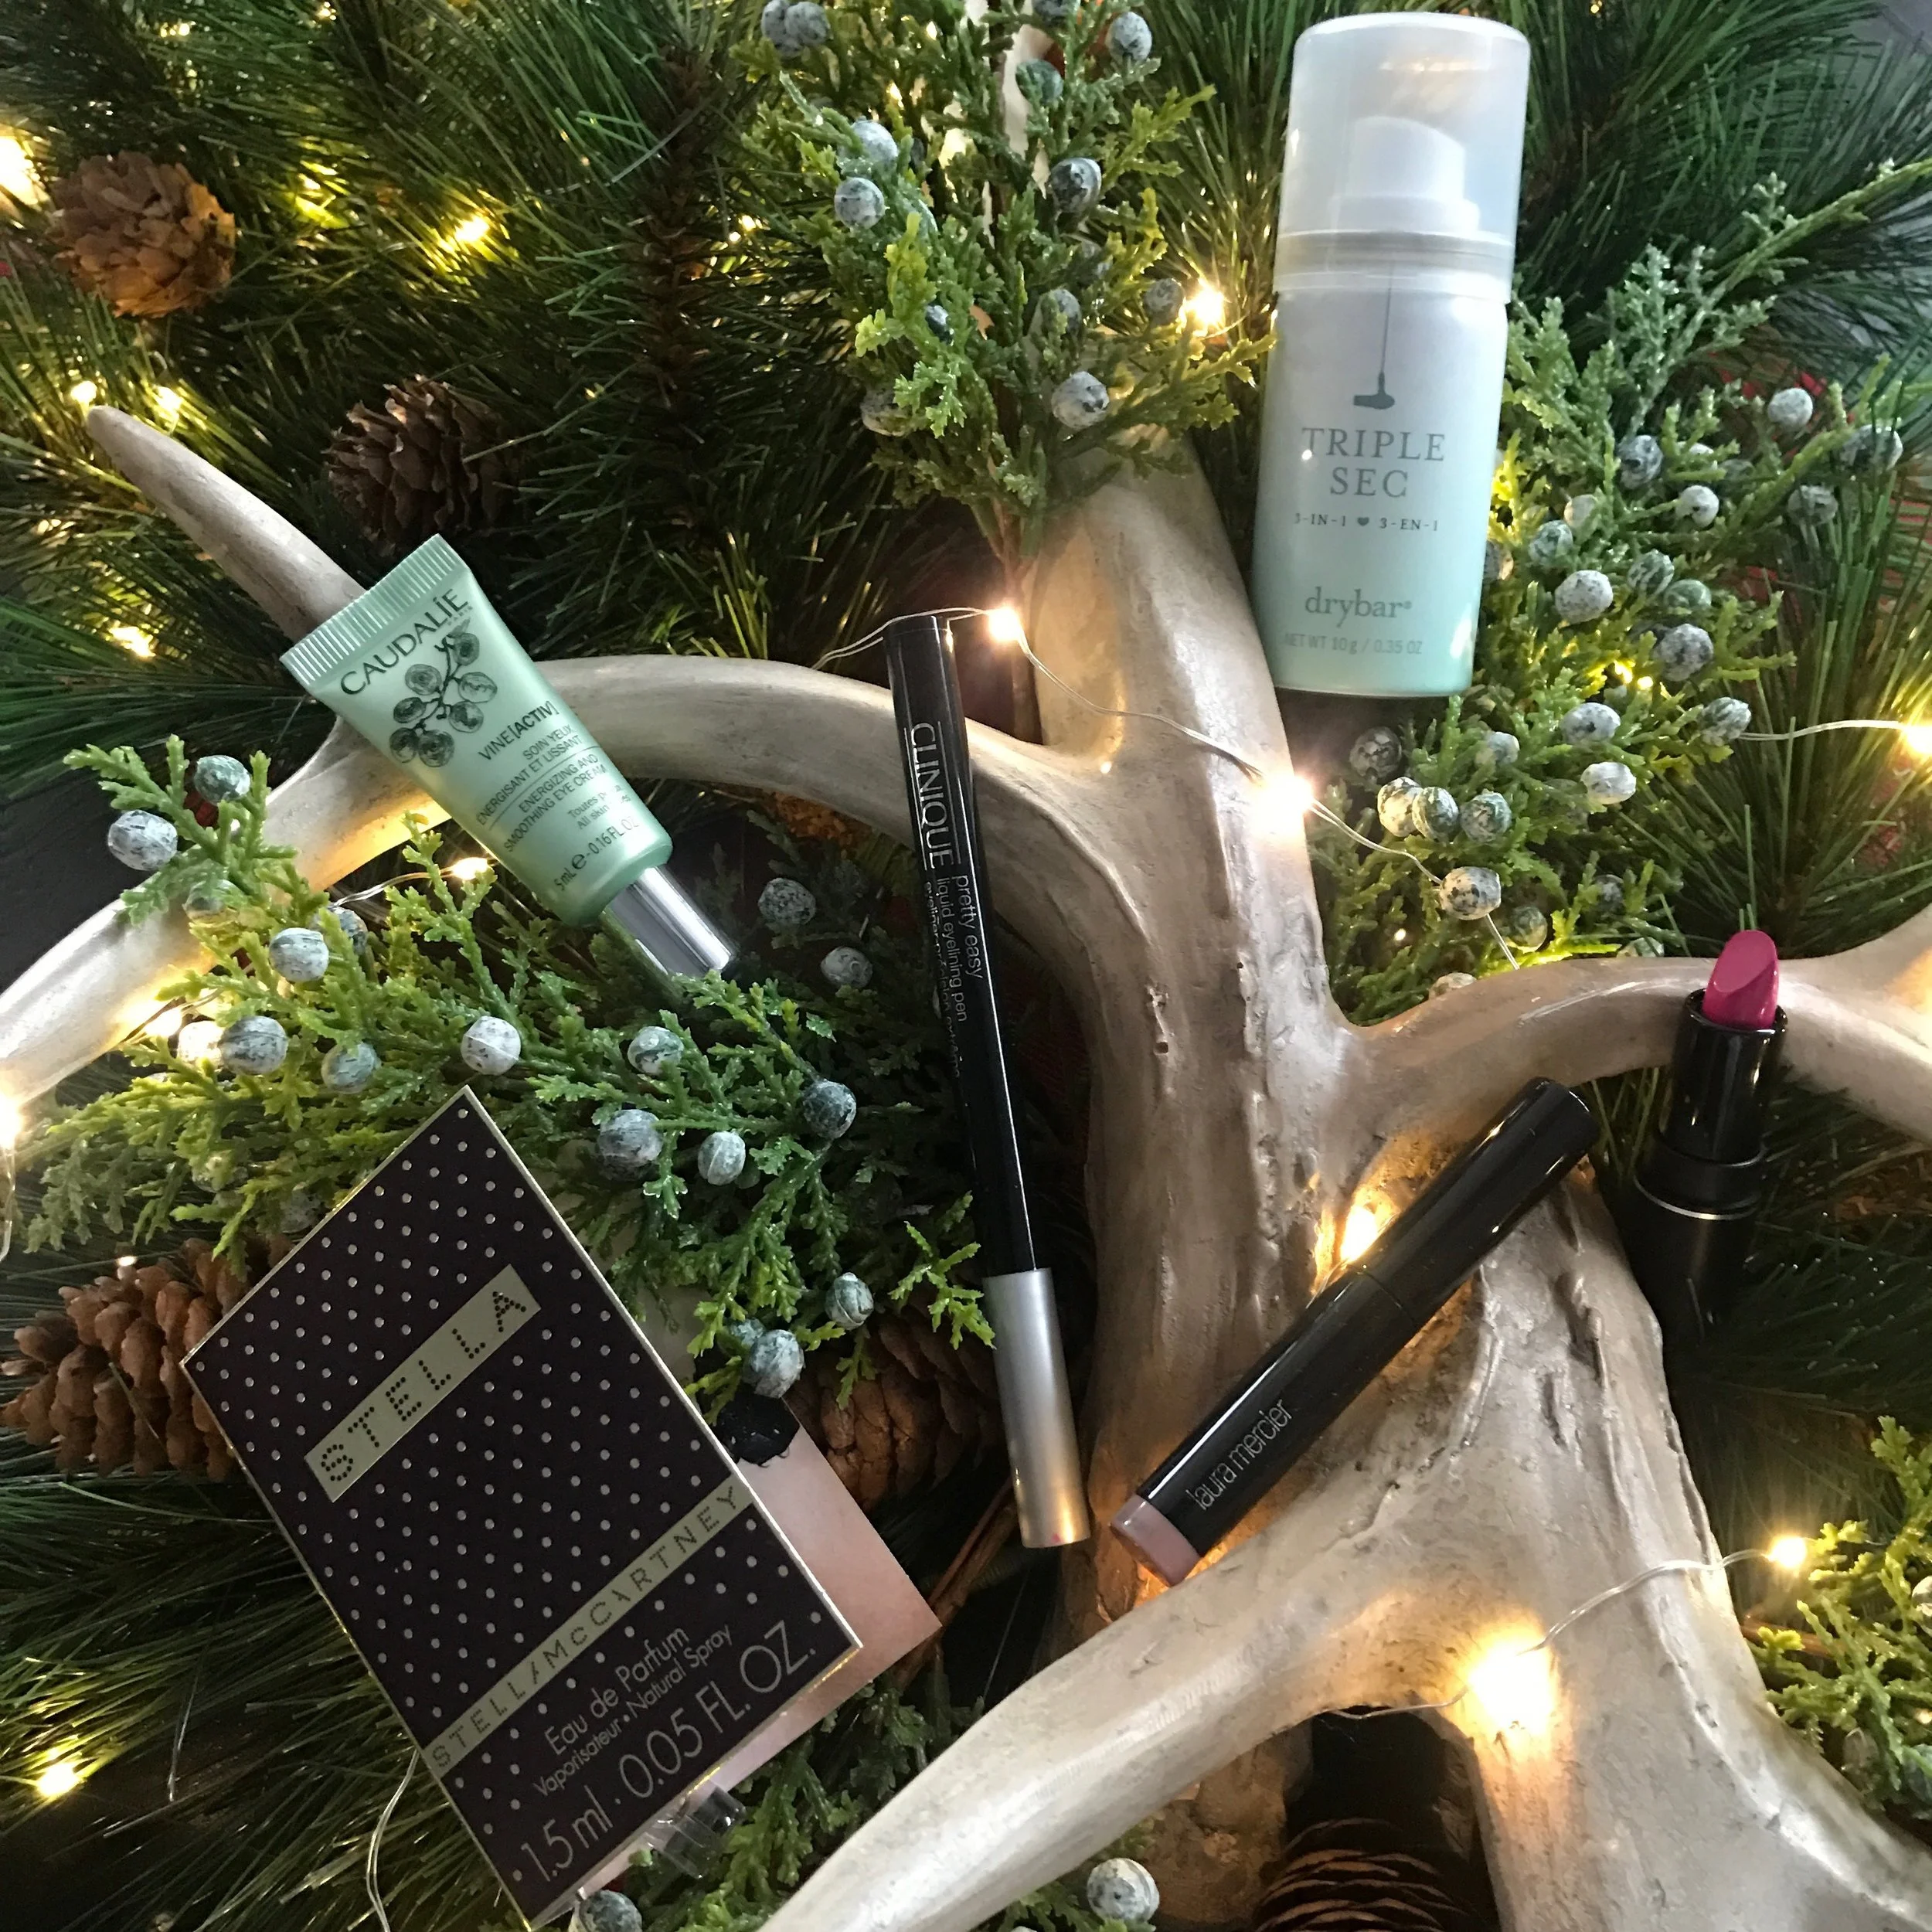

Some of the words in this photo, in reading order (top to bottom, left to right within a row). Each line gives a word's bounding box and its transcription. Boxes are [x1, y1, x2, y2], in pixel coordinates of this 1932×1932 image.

[1301, 427, 1445, 461] TRIPLE
[1330, 466, 1409, 498] SEC
[1294, 512, 1346, 527] 3-IN-1
[1379, 517, 1439, 532] 3-EN-1
[522, 738, 549, 760] SOIN
[529, 759, 544, 774] ET
[545, 734, 583, 763] LISSANT
[519, 764, 579, 813] ENERGIZING
[580, 753, 600, 771] AND
[568, 796, 599, 819] Toutes
[911, 722, 954, 869] CLINIQUE
[504, 796, 556, 852] SMOOTHING
[553, 781, 575, 801] EYE
[577, 816, 592, 830] All
[936, 877, 955, 918] liquid
[951, 875, 977, 929] pretty
[964, 934, 983, 978] easy
[942, 922, 963, 988] eyelining
[951, 992, 968, 1021] pen
[321, 1291, 526, 1482] STELLA
[1185, 1463, 1237, 1510] laura
[1229, 1400, 1292, 1471] mercier
[533, 1719, 622, 1797] Vaporisateur
[627, 1665, 687, 1719] Natural
[683, 1624, 733, 1668] Spray
[544, 1714, 588, 1755] Eau
[590, 1687, 619, 1719] de
[615, 1628, 689, 1692] Parfum
[521, 1818, 574, 1883] 1.5
[571, 1784, 614, 1849] ml
[619, 1707, 702, 1798] 0.05
[695, 1680, 751, 1734] FL.
[740, 1620, 817, 1693] OZ.
